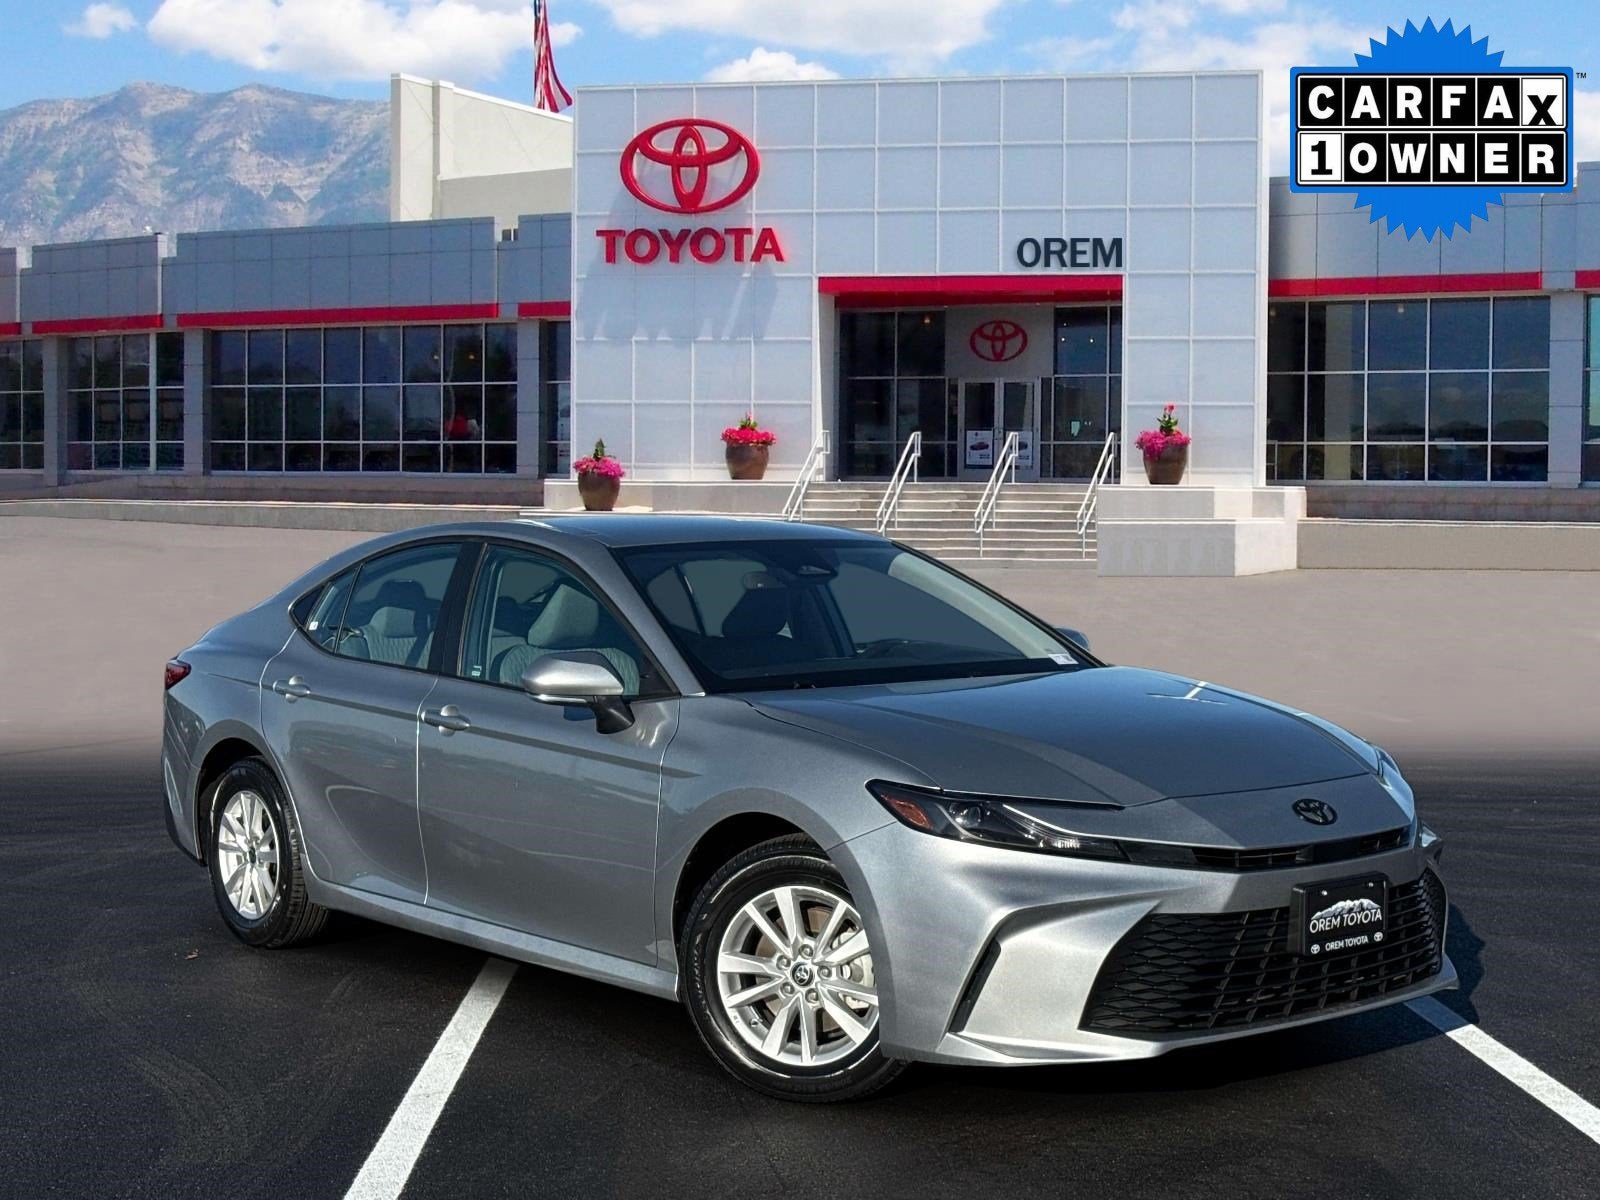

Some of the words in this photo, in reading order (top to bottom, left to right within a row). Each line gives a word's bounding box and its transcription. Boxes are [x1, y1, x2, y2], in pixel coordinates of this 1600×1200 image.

[595, 227, 785, 265] TOYOTA
[1016, 237, 1123, 269] OREM
[1309, 915, 1341, 934] OREM
[1342, 908, 1383, 927] TOYOTA
[1324, 940, 1345, 952] OREM
[1345, 935, 1369, 948] TOYOTA
